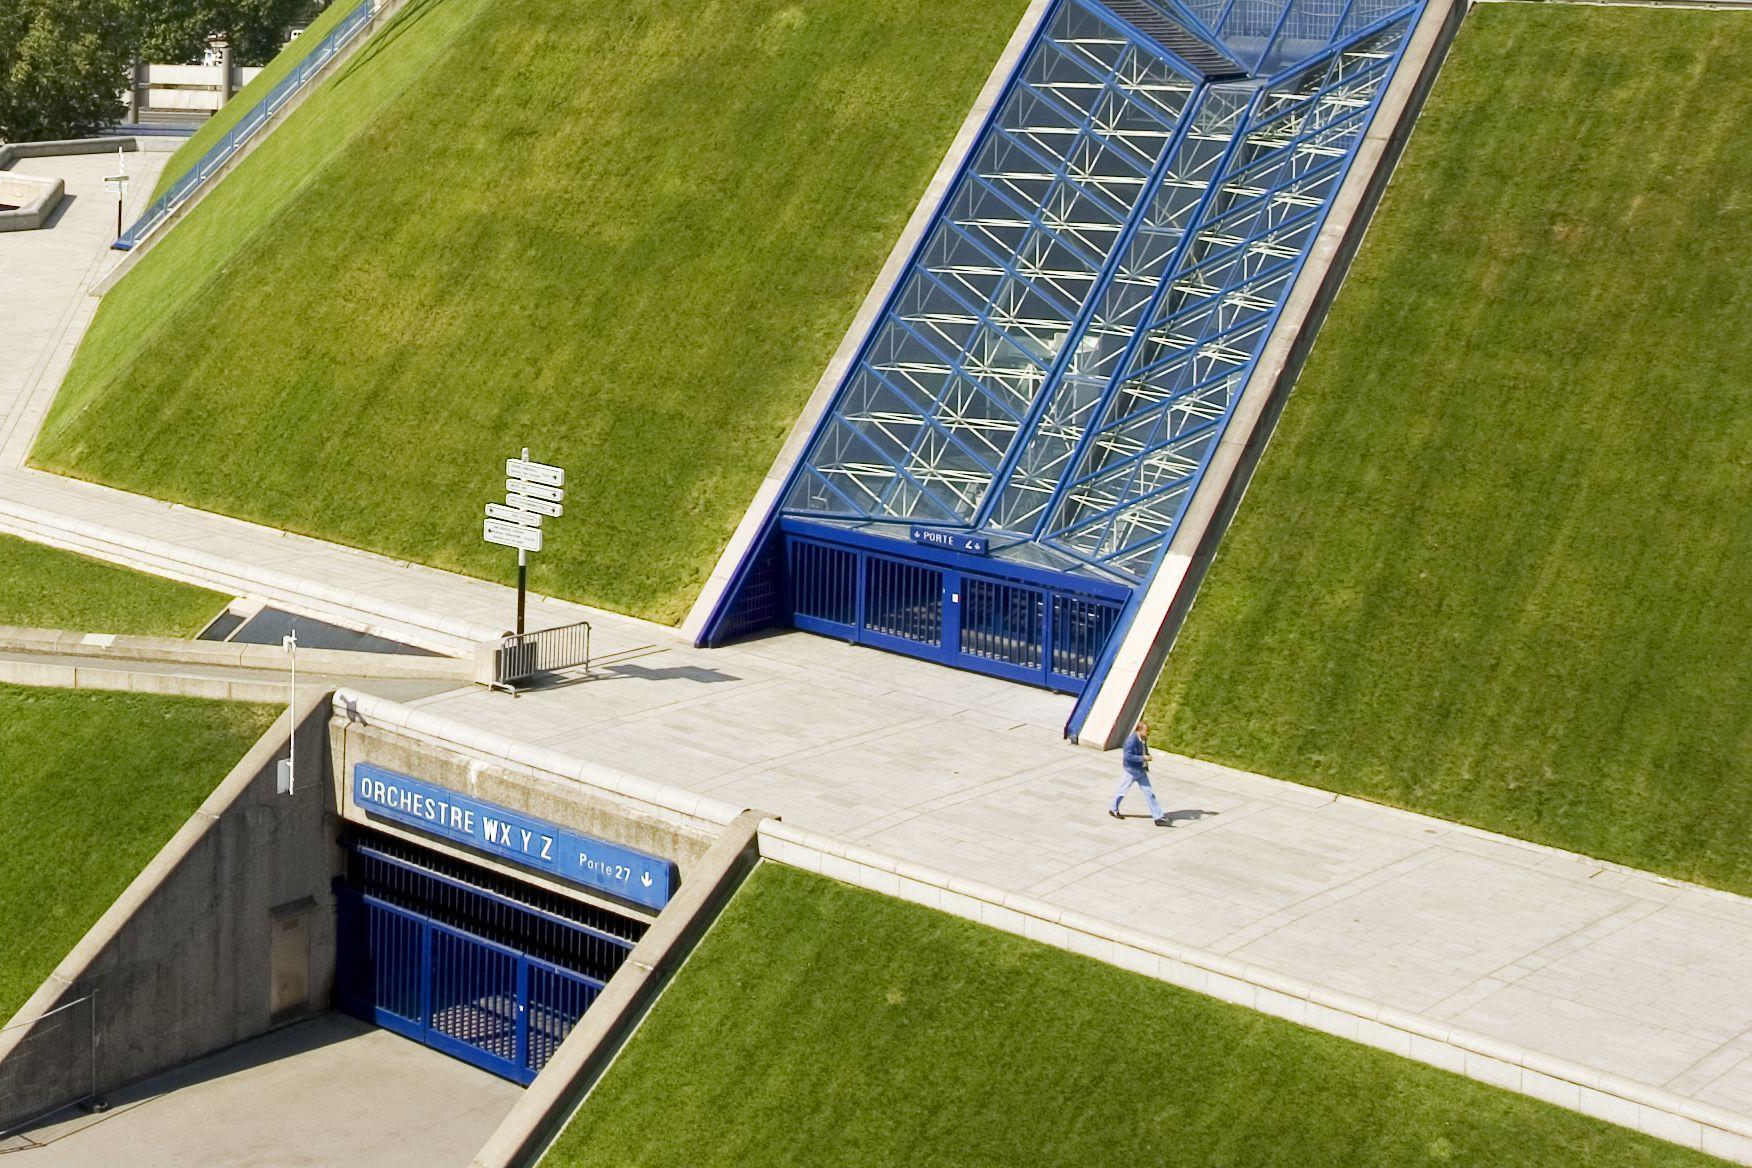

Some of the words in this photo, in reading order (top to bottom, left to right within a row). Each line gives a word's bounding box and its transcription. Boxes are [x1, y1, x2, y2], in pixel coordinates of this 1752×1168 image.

[923, 531, 954, 546] PORTE
[361, 777, 475, 834] ORCHESTRE
[579, 852, 612, 876] Porte
[615, 865, 631, 882] 27
